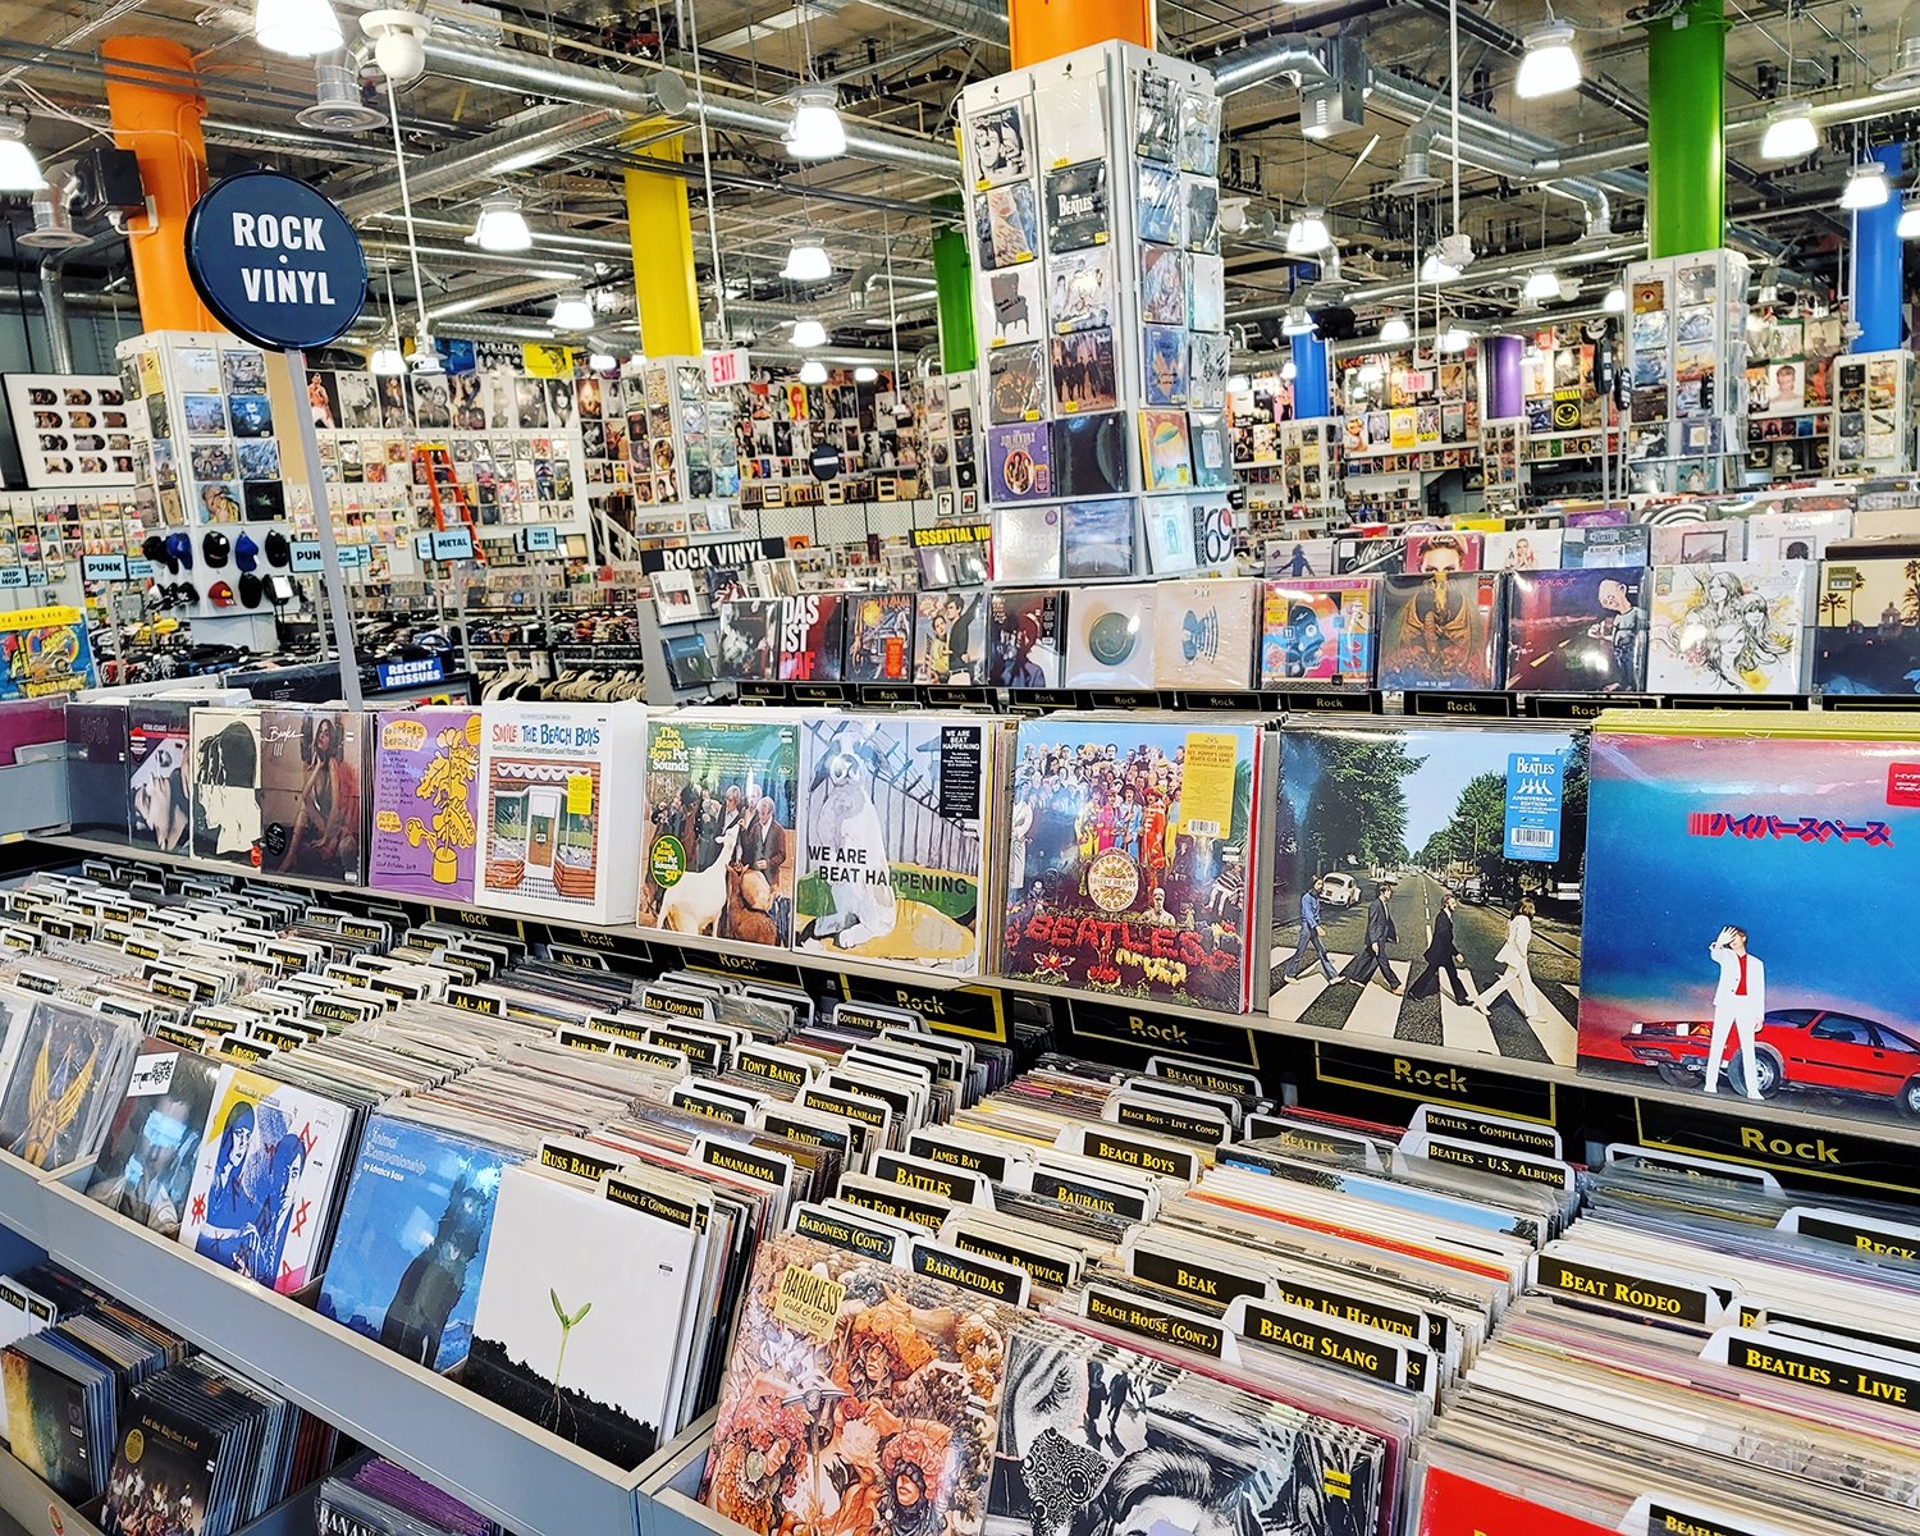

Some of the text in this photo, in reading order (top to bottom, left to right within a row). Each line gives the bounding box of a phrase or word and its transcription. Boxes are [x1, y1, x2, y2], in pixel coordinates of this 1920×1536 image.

[232, 212, 326, 252] ROCK
[241, 268, 335, 305] VINYL
[711, 353, 736, 383] EXIT
[437, 537, 468, 548] METAL
[914, 527, 974, 547] ESSENTIAL
[88, 562, 122, 573] PUNK
[296, 551, 321, 561] PUN
[662, 541, 767, 572] ROCK VINYL
[782, 595, 820, 625] DAS
[781, 624, 810, 652] IST
[386, 670, 441, 687] REISSUES
[388, 660, 433, 676] RECENT
[780, 651, 816, 681] DAF
[755, 686, 770, 694] Rock
[810, 689, 826, 697] Rock
[880, 690, 899, 700] Rock
[948, 691, 967, 701] Rock
[1035, 693, 1055, 703] Rock
[1114, 696, 1137, 704] Rock
[1211, 698, 1235, 707] Rock
[1316, 698, 1344, 708] Rock
[1447, 701, 1477, 713] Rock
[521, 723, 600, 747] THE BEACH BOYS
[655, 737, 684, 749] Beach
[661, 727, 679, 738] The
[650, 748, 689, 760] Boys Pet
[942, 743, 980, 751] HAPPENING
[652, 759, 689, 772] Sounds
[1516, 757, 1555, 776] BEATLES
[1700, 812, 1894, 848] ハイパースペース
[808, 846, 867, 865] WE ARE
[819, 866, 968, 895] BEAT HAPPENING
[461, 910, 489, 926] Rock
[343, 924, 380, 939] ARCADE FIRE
[581, 930, 614, 947] Rock
[1026, 914, 1205, 962] BEATLES
[718, 953, 759, 972] Rock
[456, 996, 491, 1013] AA AM
[646, 996, 703, 1019] BAD COMPANY
[896, 989, 946, 1015] Rock
[838, 1011, 874, 1028] COURTNEY
[1129, 1015, 1189, 1044] Rock
[229, 1044, 259, 1063] ARGENT
[680, 1043, 706, 1060] METAL
[741, 1057, 801, 1085] TONY BANKS
[1167, 1067, 1245, 1095] BEACH HOUSE
[1394, 1057, 1469, 1093] Rock
[683, 1099, 734, 1124] THE BAND
[807, 1096, 883, 1124] DEVENDRA BANHART
[1122, 1108, 1220, 1137] BEACH BOYS LIVE COMPS
[787, 1127, 822, 1146] BANDIT
[1280, 1131, 1336, 1154] BEATLES
[1427, 1114, 1555, 1149] BEATLES COMPILATIONS
[1099, 1142, 1175, 1174] BEACH BOYS
[1740, 1126, 1840, 1165] Rock
[542, 1150, 569, 1170] RUSS
[711, 1151, 775, 1183] BANANARAMA
[931, 1148, 981, 1171] JAMES BAY
[1430, 1144, 1475, 1165] BEATLES
[1487, 1157, 1514, 1174] U.S.
[1517, 1164, 1565, 1186] ALBUMS
[896, 1167, 952, 1197] BATTLES
[608, 1184, 639, 1205] BALANCE
[640, 1196, 646, 1207] &
[648, 1197, 690, 1222] COMPOSURE
[848, 1194, 943, 1230] BAT FOR LASHES
[1057, 1187, 1115, 1215] BAUHAUS
[798, 1214, 893, 1257] BARONESS (CONT.)
[1855, 1235, 1917, 1260] BECK
[924, 1257, 1005, 1296] BARRACUDAS
[1010, 1256, 1064, 1285] BARWICK
[1178, 1269, 1217, 1296] BEAK
[782, 1267, 843, 1316] BARONESS
[1560, 1269, 1682, 1315] BEAT RODEO
[783, 1298, 802, 1313] Gold
[811, 1310, 829, 1328] Grey
[1091, 1299, 1218, 1350] BEACH HOUSE (CONT.)
[1279, 1288, 1315, 1312] BEAR
[1321, 1299, 1339, 1317] IN
[1346, 1306, 1414, 1338] HEAVEN
[1259, 1318, 1315, 1352] BEACH
[1321, 1338, 1378, 1371] SLANG
[1746, 1348, 1831, 1385] BEATLES
[1857, 1374, 1907, 1404] LIVE
